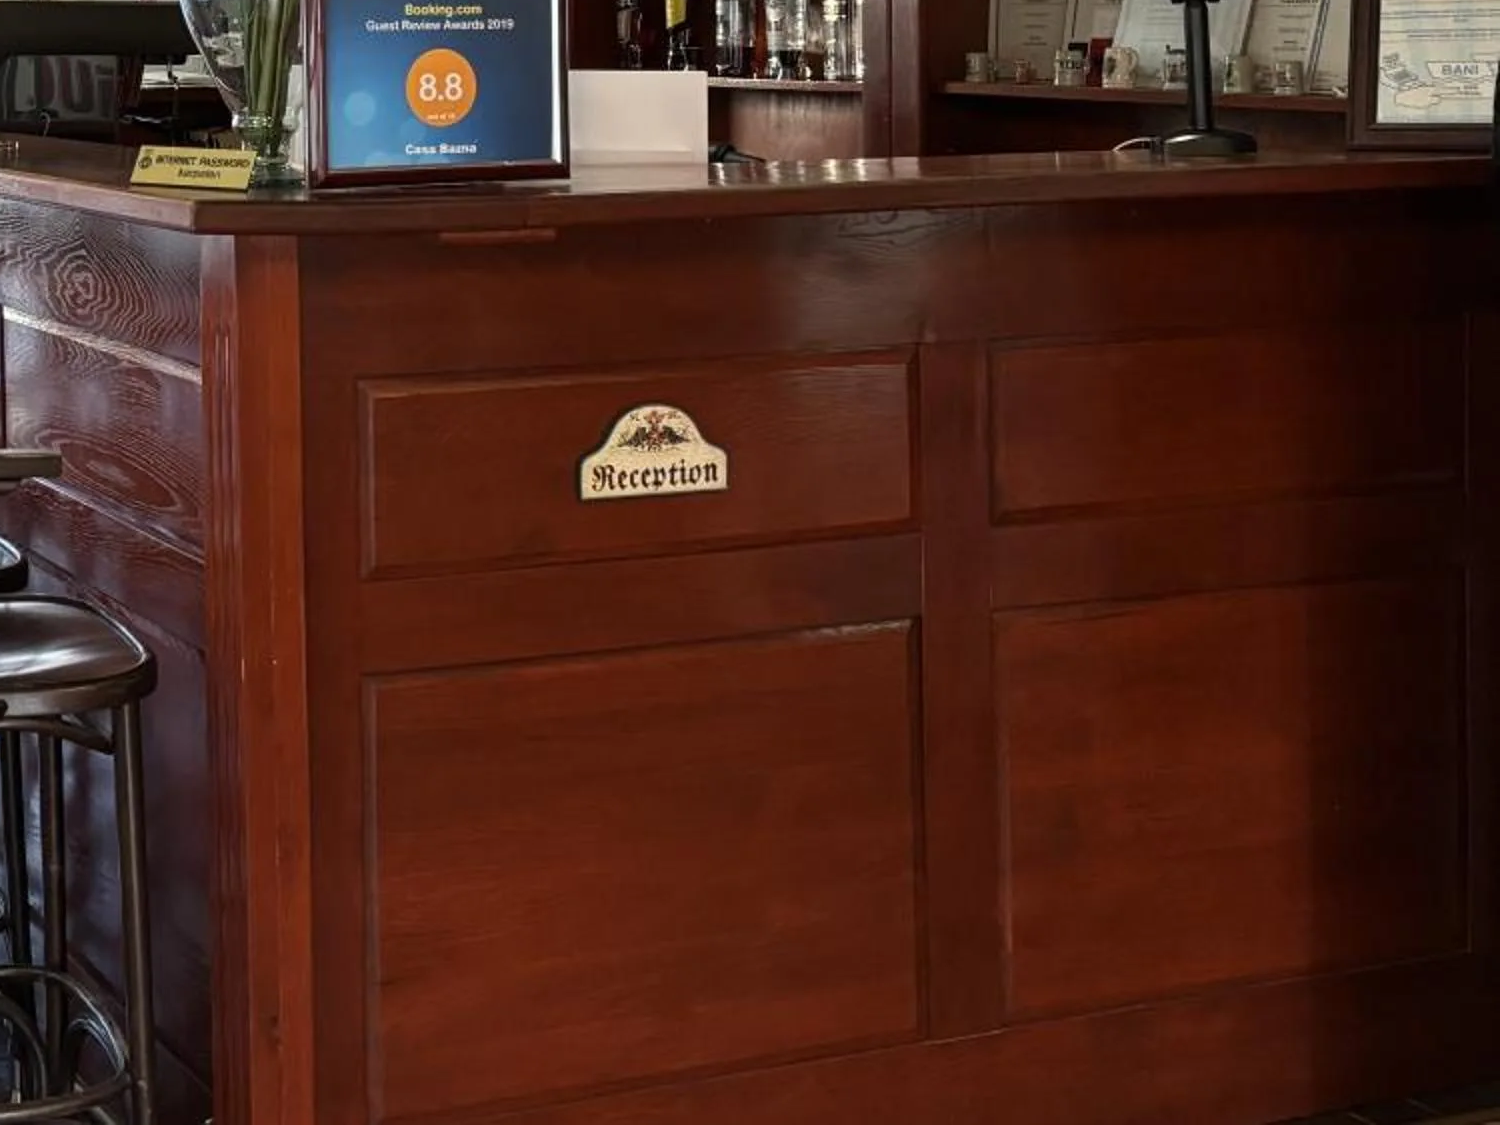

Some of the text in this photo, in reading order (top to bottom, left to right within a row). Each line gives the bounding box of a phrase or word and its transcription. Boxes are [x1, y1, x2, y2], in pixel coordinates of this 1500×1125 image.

[404, 3, 483, 17] Booking.com
[364, 18, 515, 31] Guest Review Awards 2019
[419, 72, 463, 102] 8.8
[405, 143, 437, 155] Casa
[592, 458, 719, 492] Reception
